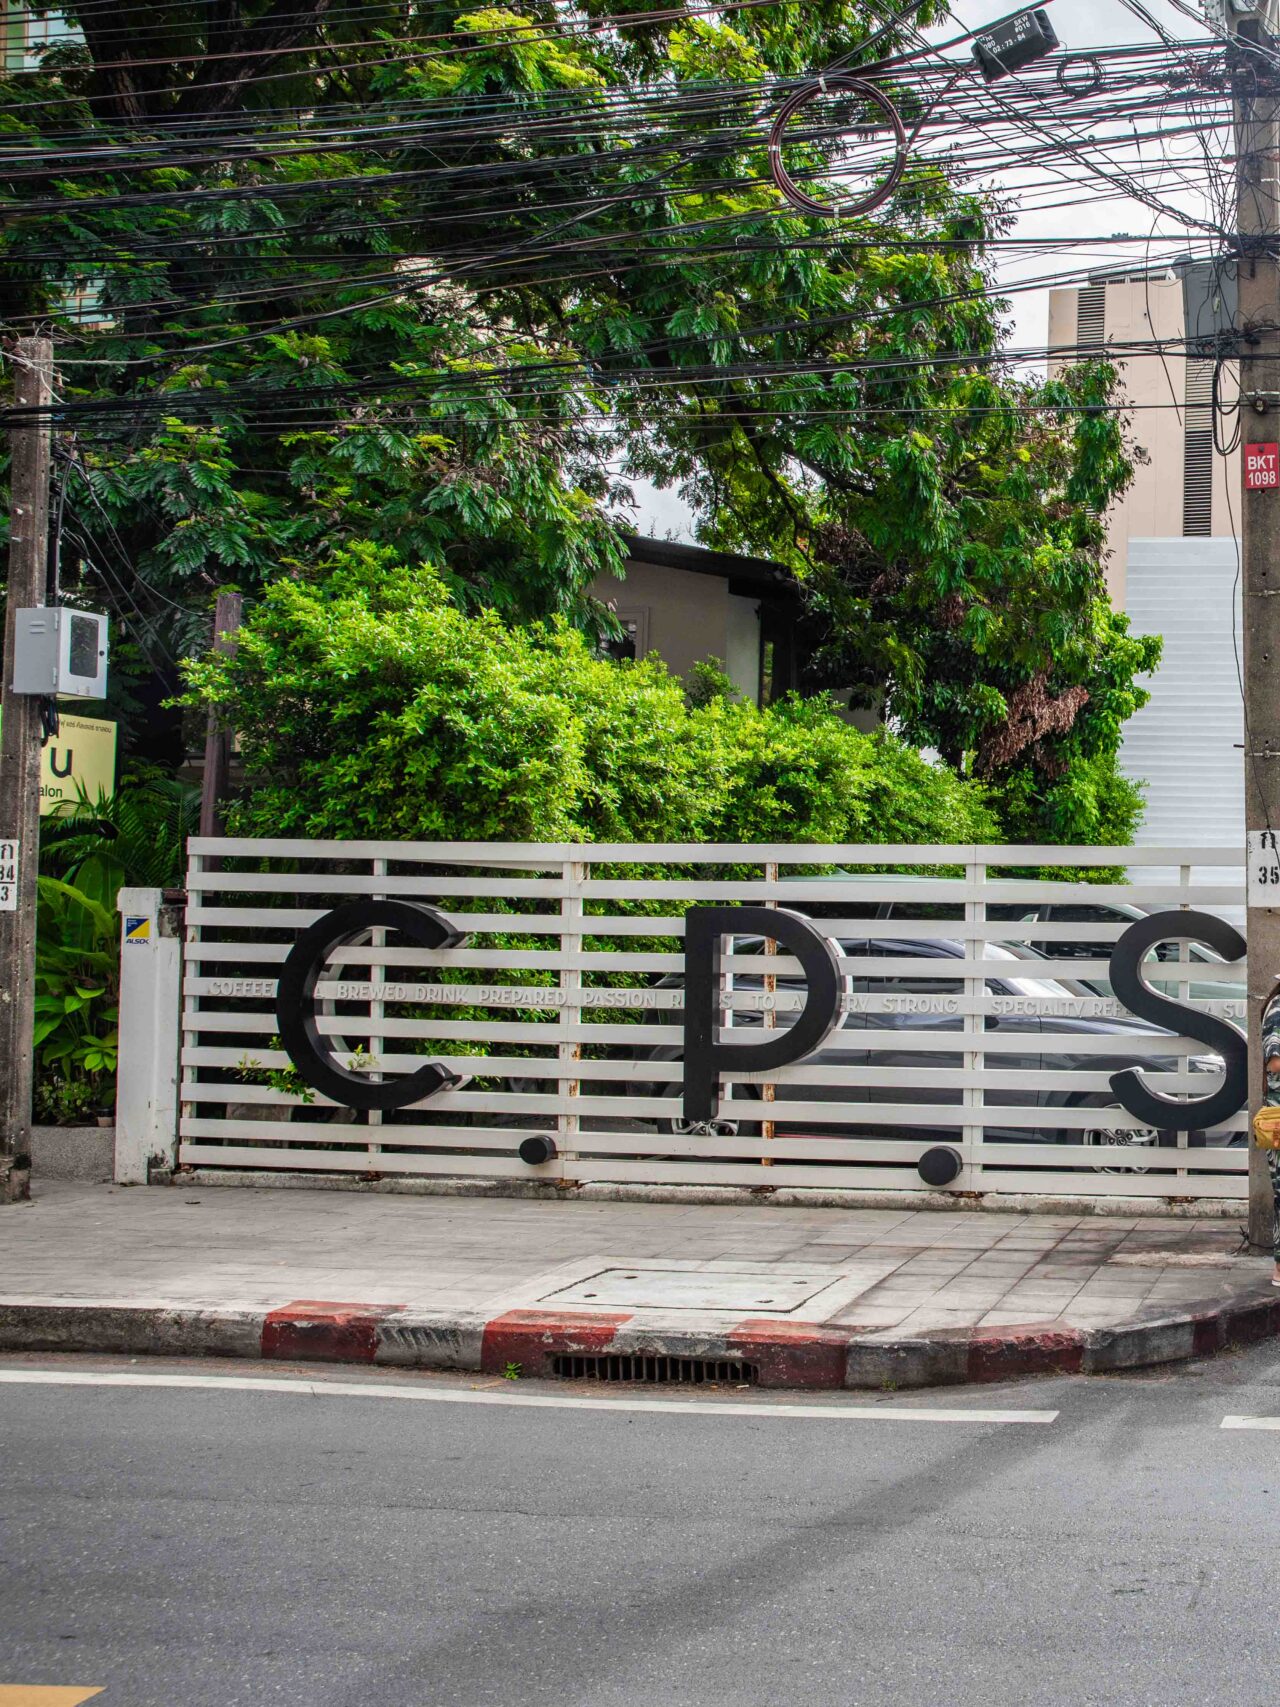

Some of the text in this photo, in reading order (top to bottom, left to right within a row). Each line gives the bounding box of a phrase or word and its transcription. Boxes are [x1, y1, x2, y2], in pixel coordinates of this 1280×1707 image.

[1247, 455, 1276, 470] BKT
[1248, 471, 1276, 486] 1098
[40, 784, 63, 798] alon
[1258, 866, 1280, 885] 35
[1, 886, 9, 902] 3
[209, 981, 274, 997] COFFEE
[336, 984, 406, 1000] BREWED
[415, 985, 469, 1004] DRINK
[584, 989, 657, 1007] PASSION
[752, 994, 776, 1010] TO
[882, 997, 958, 1014] STRONG
[991, 999, 1083, 1018] SPECIALTY
